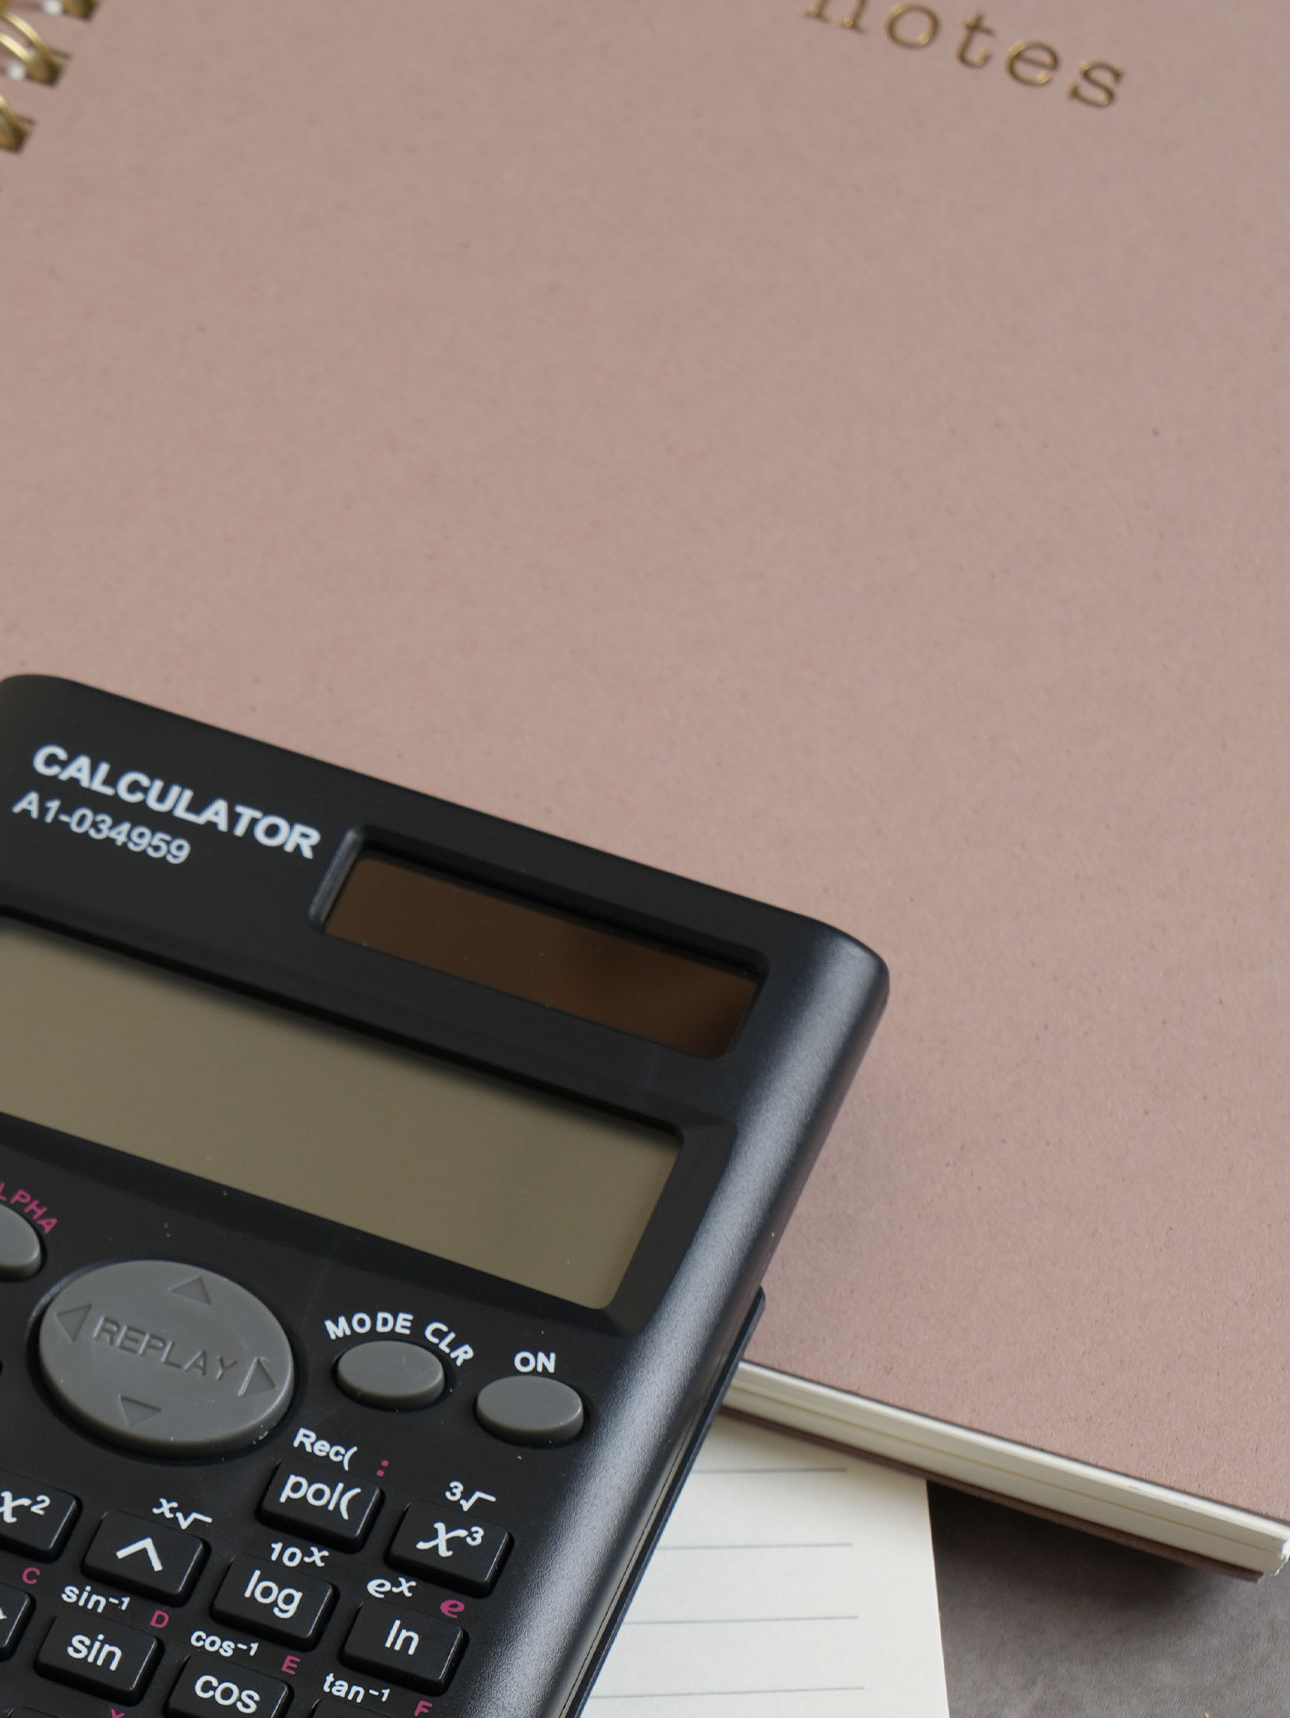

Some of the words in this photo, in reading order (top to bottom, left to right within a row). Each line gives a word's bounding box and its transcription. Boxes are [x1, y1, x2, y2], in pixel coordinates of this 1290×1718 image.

[32, 743, 323, 861] CALCULATOR
[12, 790, 192, 864] A1-034959
[91, 1316, 239, 1382] REPLAY
[324, 1311, 414, 1340] MODE
[424, 1322, 474, 1368] CLR
[514, 1351, 556, 1374] ON
[293, 1427, 358, 1471] Rec(
[21, 1566, 41, 1585] C
[244, 1569, 303, 1619] log
[150, 1609, 170, 1628] D
[439, 1599, 465, 1618] e
[67, 1634, 122, 1671] sin
[281, 1654, 301, 1675] E
[194, 1675, 261, 1714] cos
[414, 1699, 433, 1717] F
